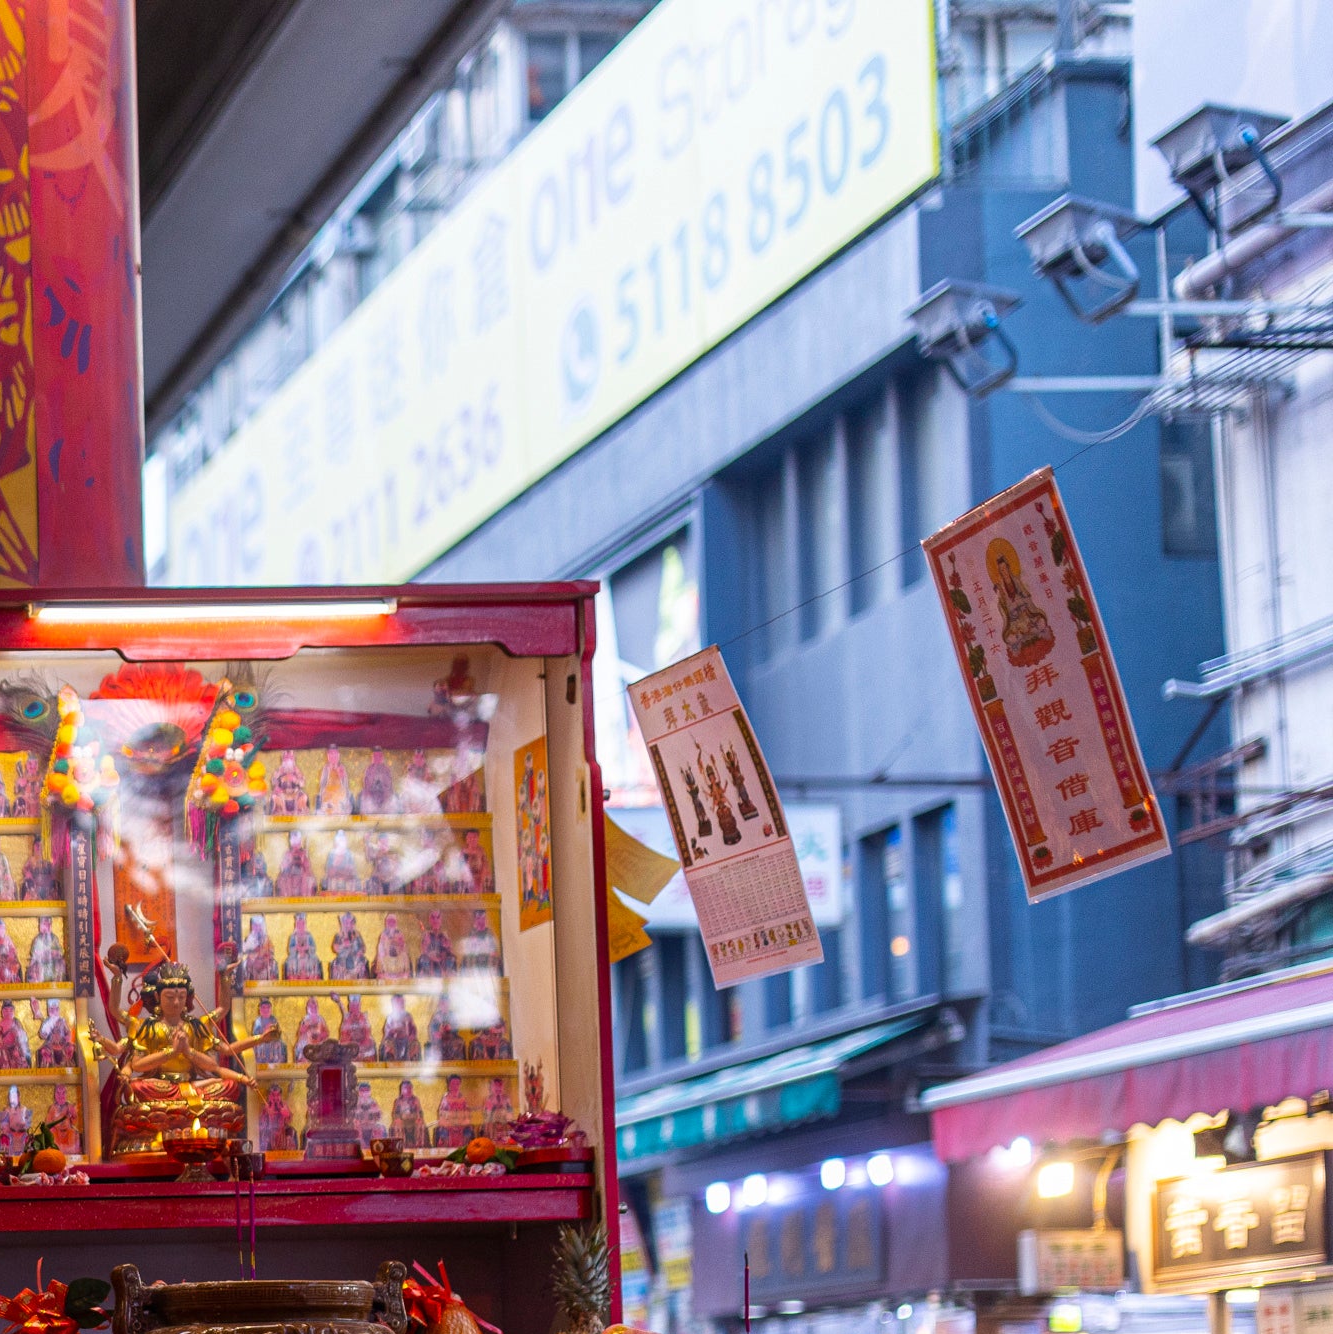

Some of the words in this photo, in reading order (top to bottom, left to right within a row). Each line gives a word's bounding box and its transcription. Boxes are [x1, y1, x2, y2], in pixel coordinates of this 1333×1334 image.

[528, 103, 635, 275] one
[615, 190, 731, 365] 5118
[746, 52, 891, 260] 8503
[972, 581, 1001, 655] 正月二十六
[1024, 662, 1105, 837] 拜觀音借庫
